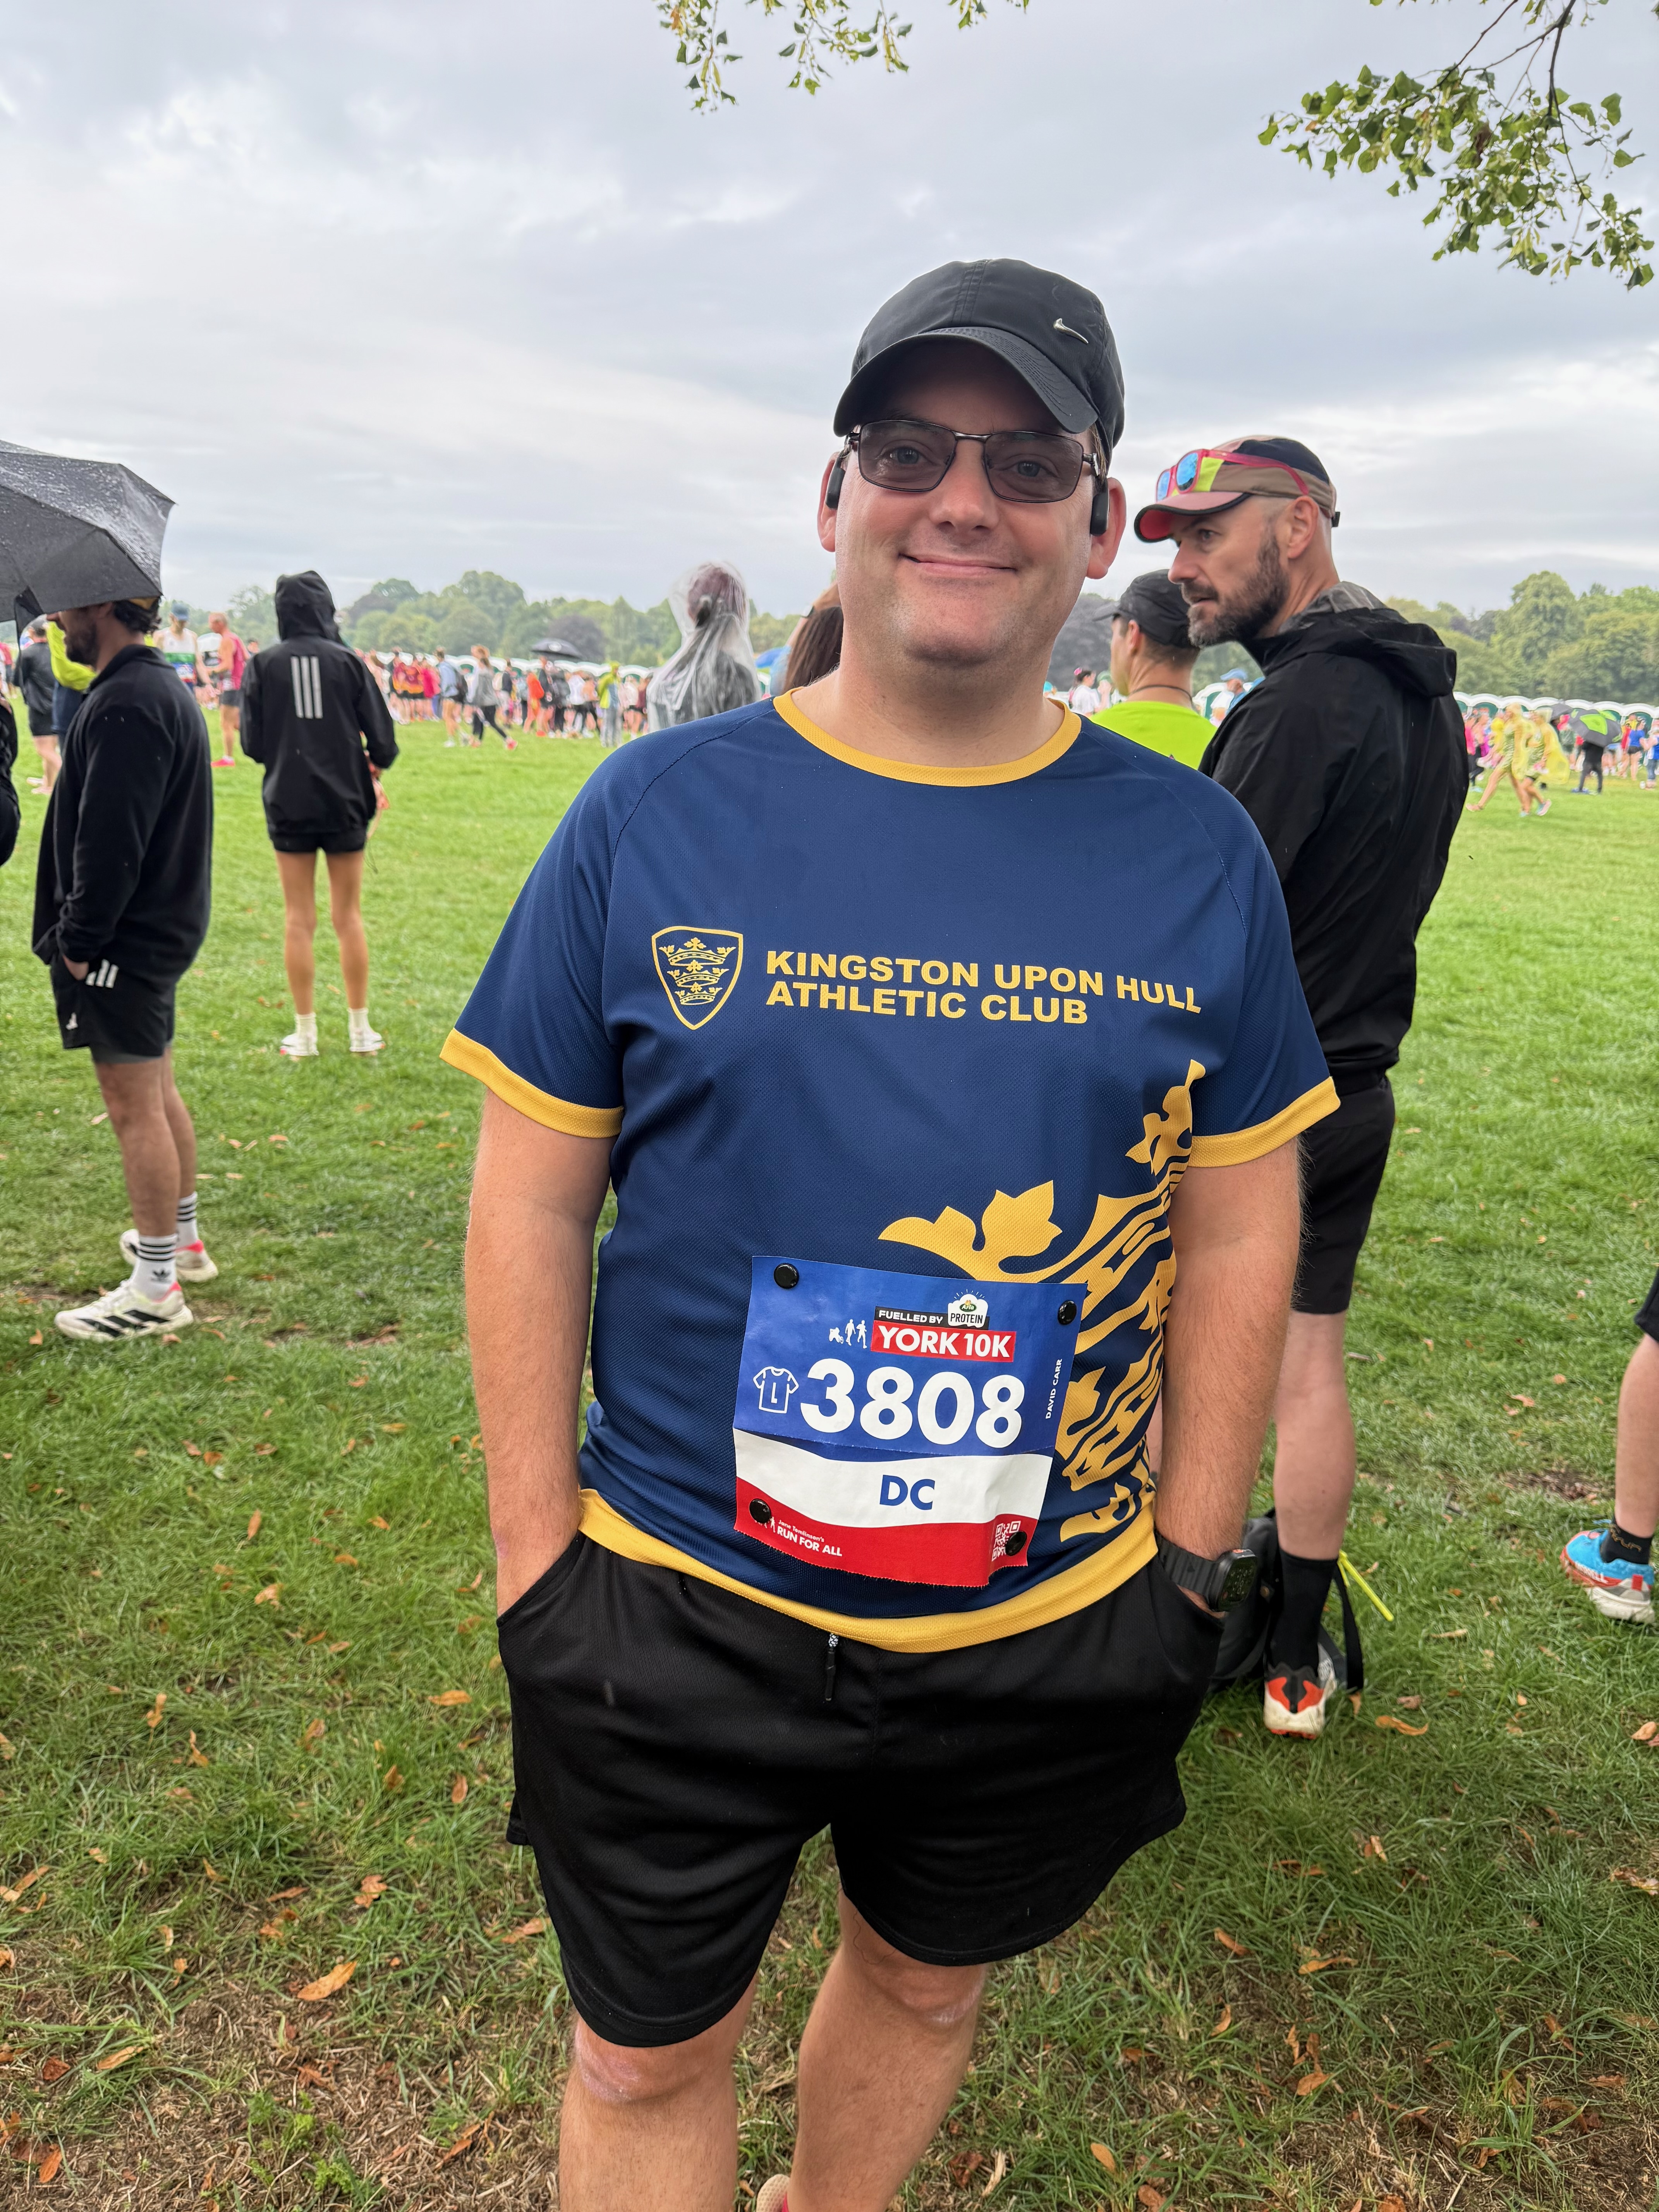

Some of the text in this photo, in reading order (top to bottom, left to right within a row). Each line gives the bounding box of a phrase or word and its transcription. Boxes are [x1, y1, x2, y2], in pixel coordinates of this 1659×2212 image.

[767, 951, 1201, 1014] KINGSTON UPON HULL
[766, 981, 1087, 1024] ATHLETIC CLUB
[878, 1310, 943, 1324] FUELLED BY
[950, 1313, 983, 1324] PROTEIN
[878, 1325, 1012, 1358] YORK 10K
[771, 1382, 778, 1404] L
[800, 1358, 1025, 1448] 3808
[1045, 1359, 1063, 1419] DAVID CARR
[879, 1474, 936, 1510] DC
[777, 1526, 842, 1557] RUN FOR ALL
[778, 1520, 824, 1542] Jane Tomlinson's
